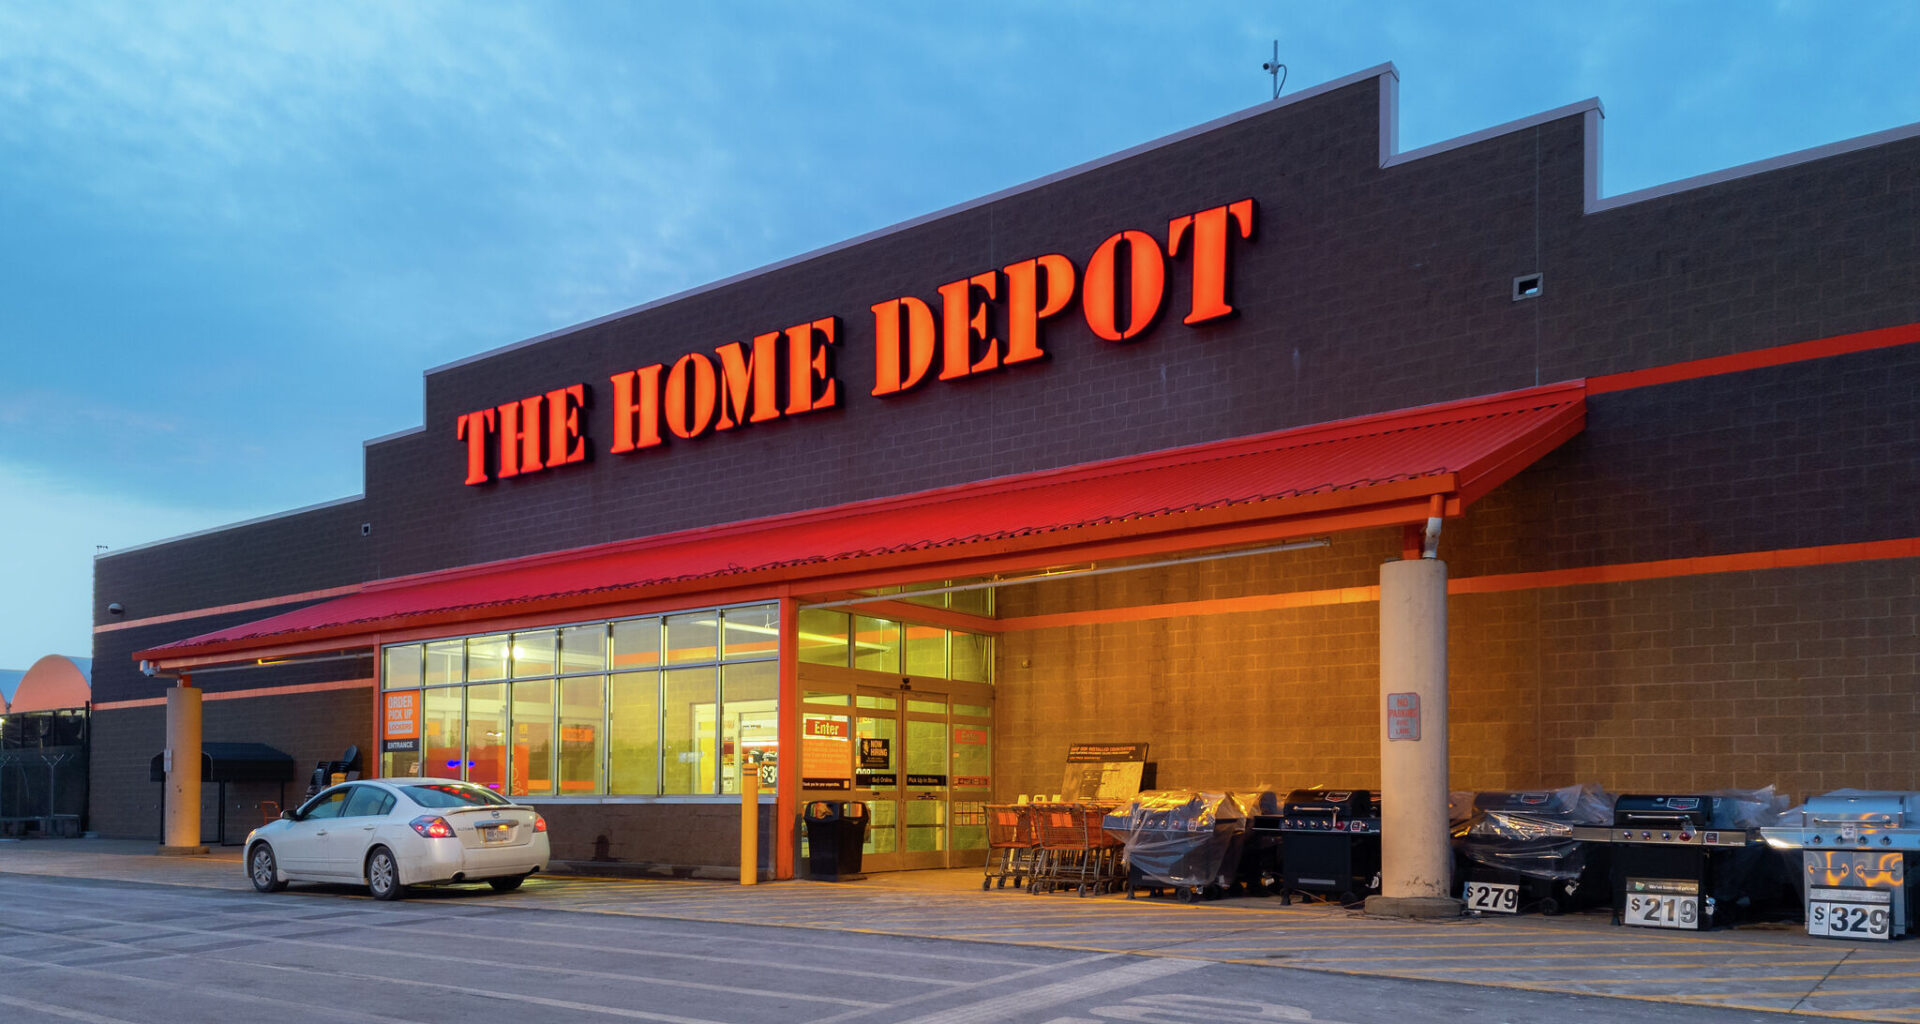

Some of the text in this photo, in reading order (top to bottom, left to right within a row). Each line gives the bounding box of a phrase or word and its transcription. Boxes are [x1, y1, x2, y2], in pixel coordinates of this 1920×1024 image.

[457, 198, 1254, 486] THE HOME DEPOT
[388, 695, 413, 709] ORDER
[1397, 698, 1408, 707] NO
[388, 708, 413, 721] PICK UP
[1388, 709, 1417, 718] PARKING
[814, 721, 840, 735] Enter
[387, 741, 414, 749] ENTRANCE
[870, 740, 883, 748] NOW
[870, 748, 888, 757] HIRING
[762, 765, 777, 784] $3
